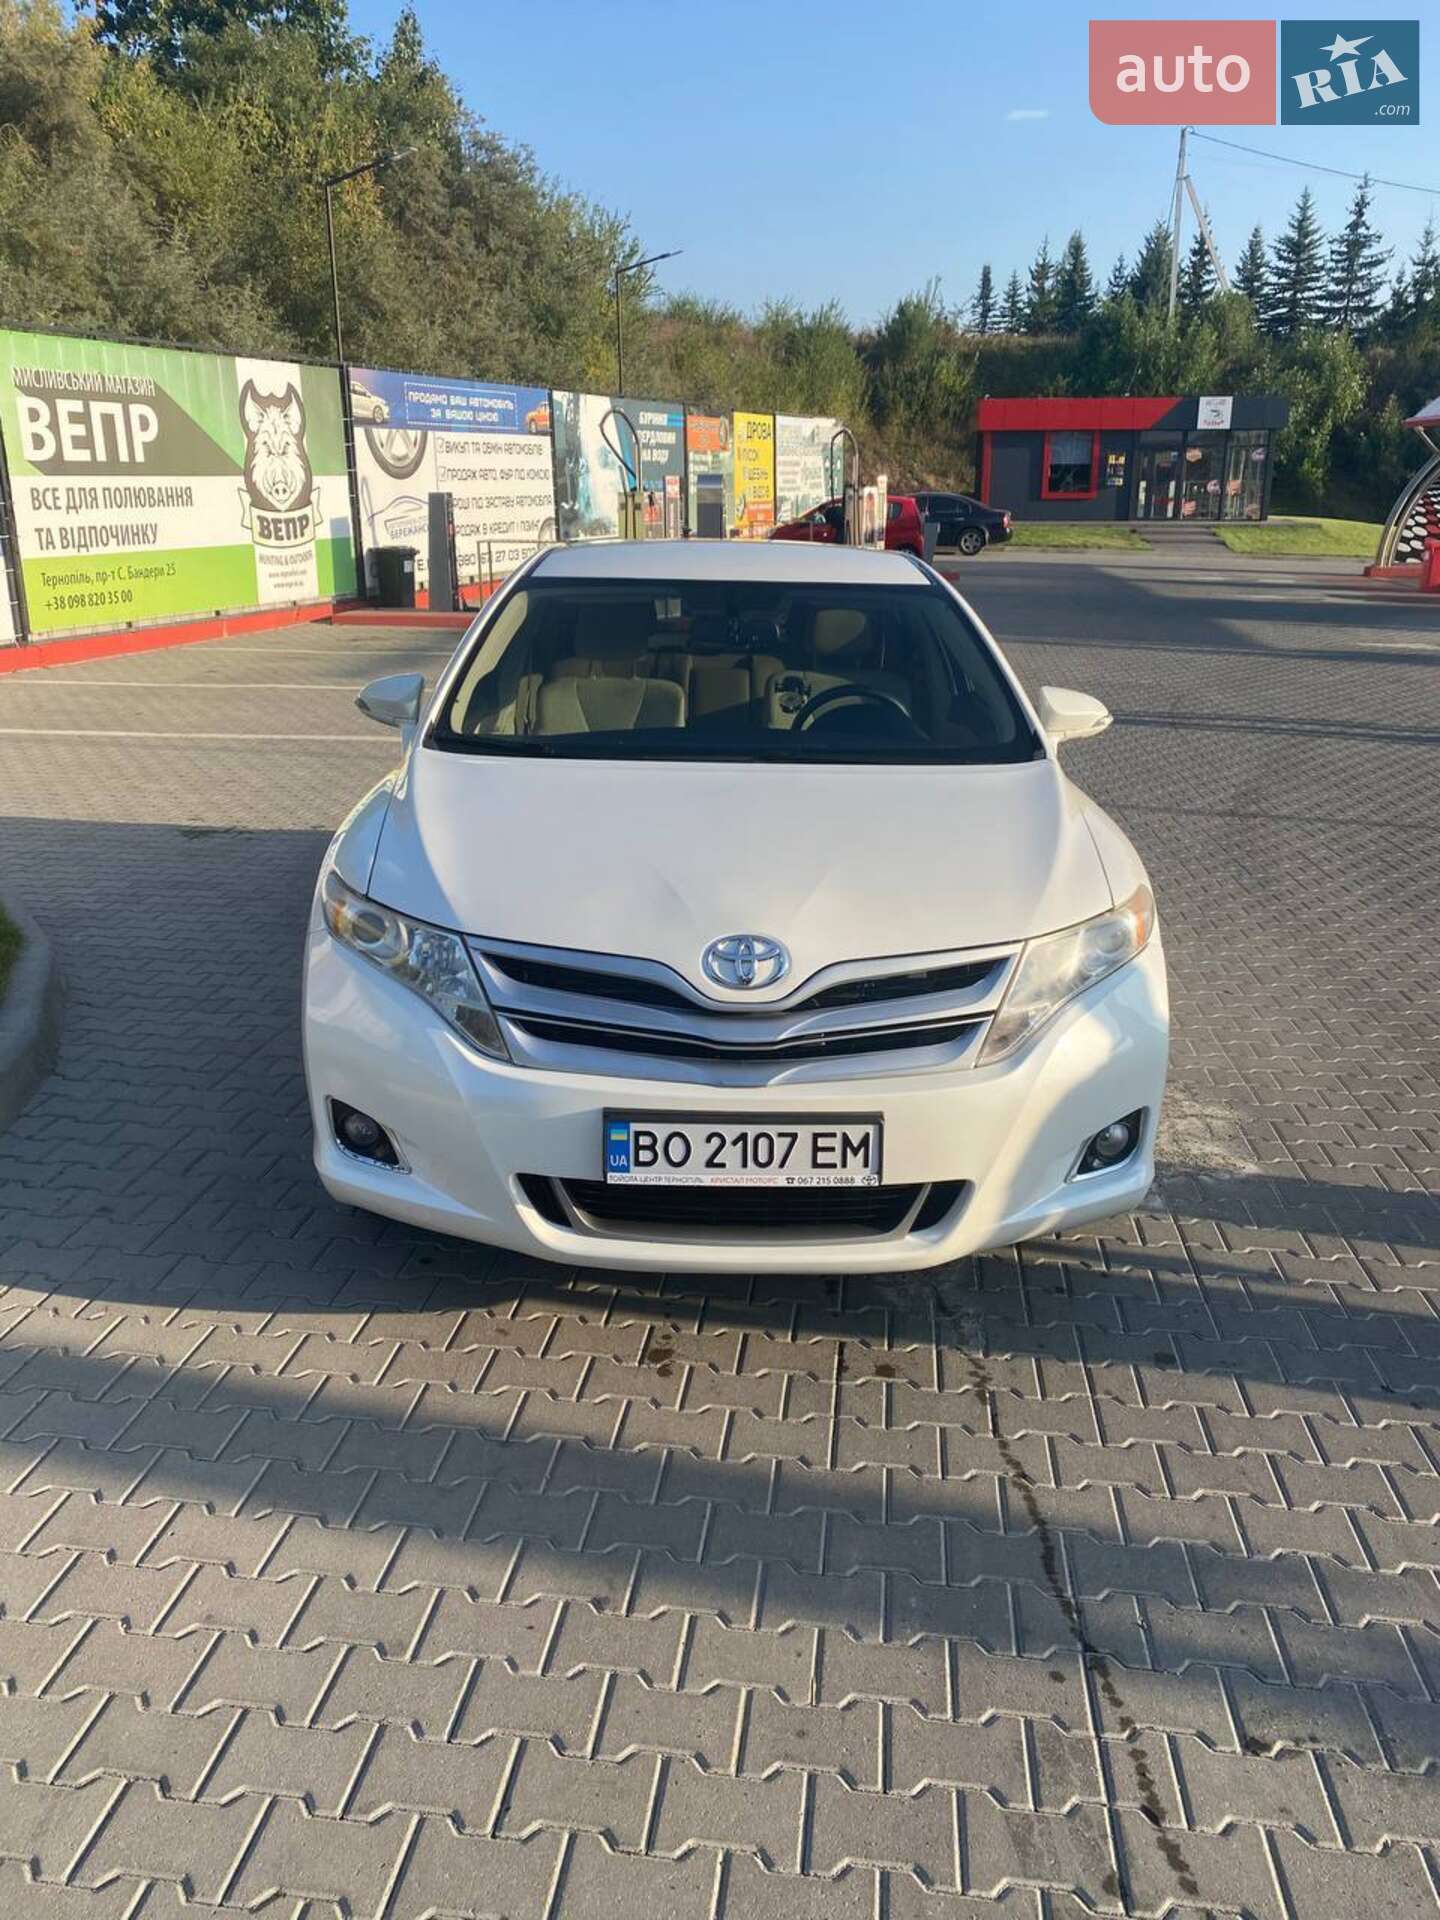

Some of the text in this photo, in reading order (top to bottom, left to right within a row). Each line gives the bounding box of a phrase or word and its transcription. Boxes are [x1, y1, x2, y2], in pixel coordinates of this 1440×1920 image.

[105, 375, 156, 397] МАГАЗИН
[16, 395, 159, 463] ВЕПР
[29, 486, 194, 514] ВСЕ ДЛЯ ПОЛЮВАННЯ
[34, 523, 158, 552] ТА ВІДПОЧИНКУ
[256, 513, 310, 541] ВЕПР
[40, 568, 94, 590] Тернопіль,
[68, 594, 86, 609] 098
[108, 591, 119, 605] 35
[121, 589, 133, 603] 00
[610, 1155, 628, 1167] UA
[633, 1130, 871, 1169] BO 2107 EM
[797, 1176, 815, 1185] 067
[816, 1176, 832, 1185] 215
